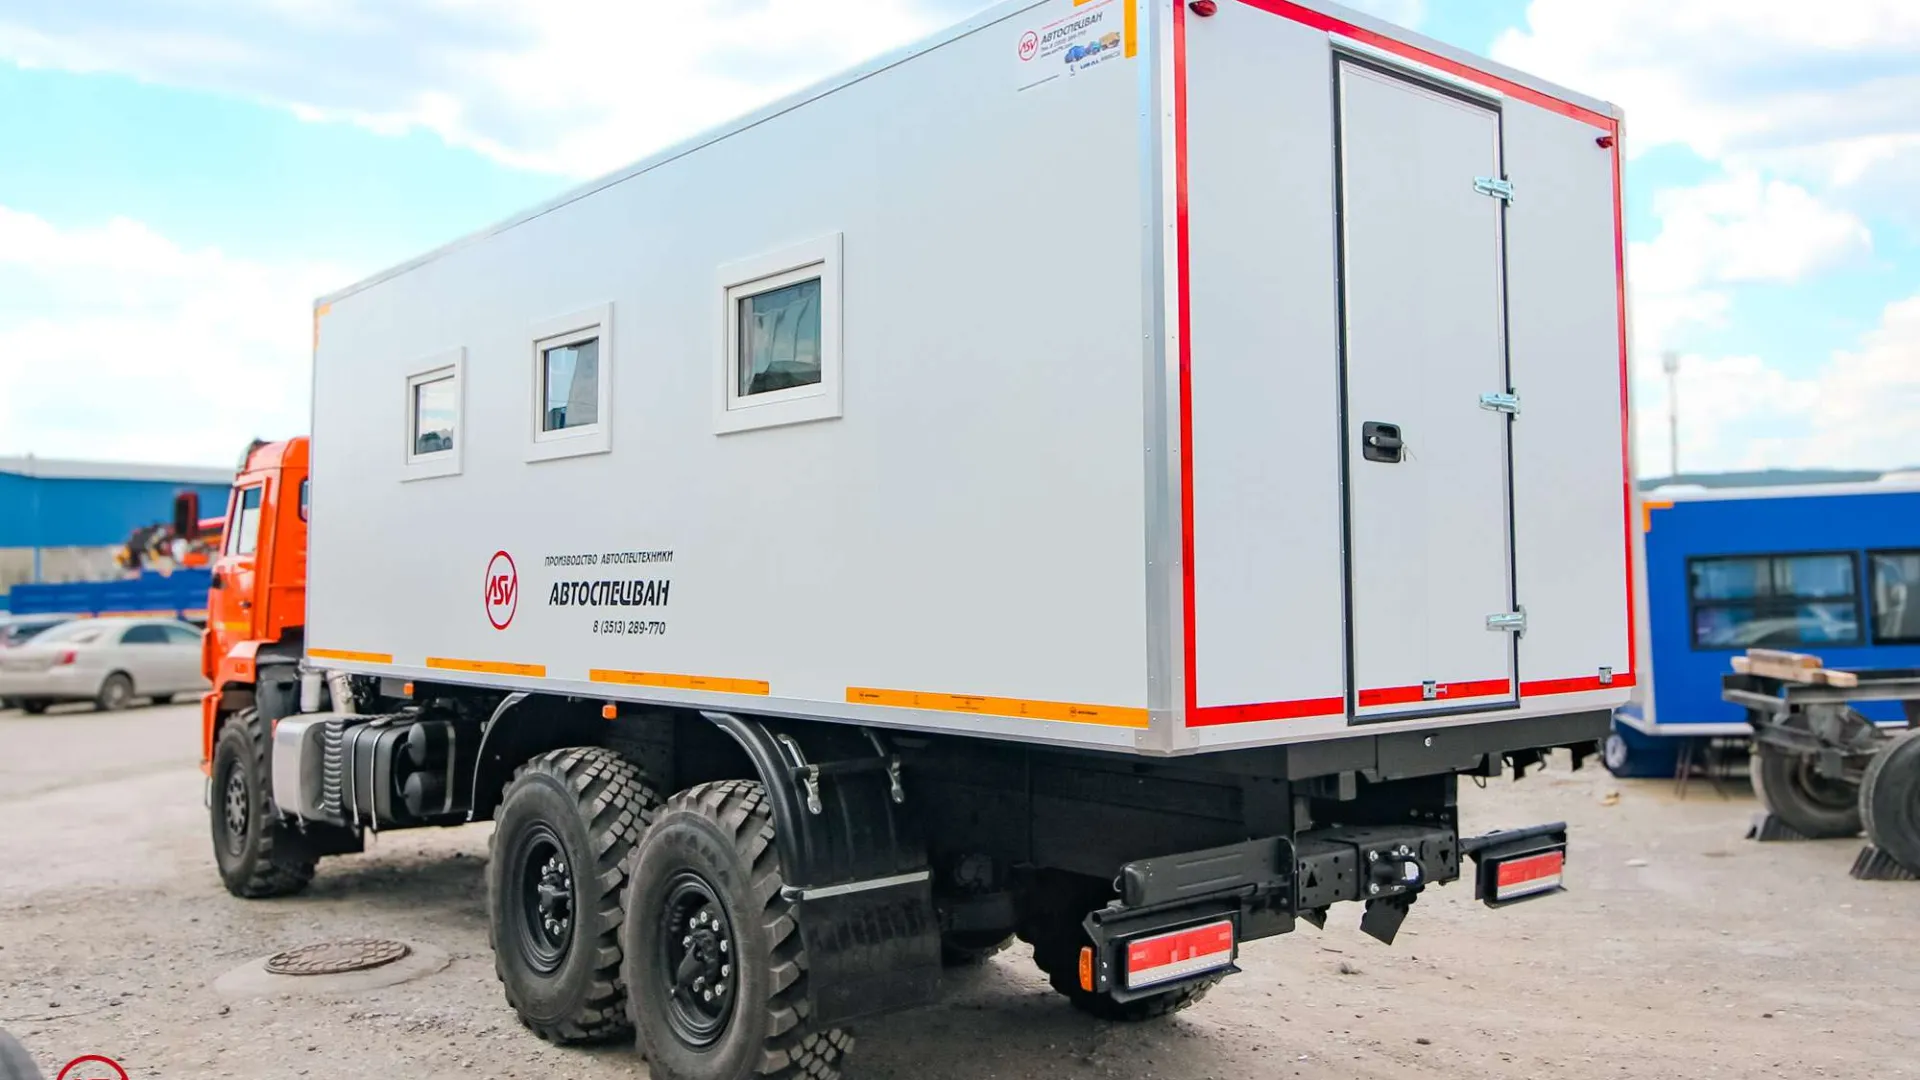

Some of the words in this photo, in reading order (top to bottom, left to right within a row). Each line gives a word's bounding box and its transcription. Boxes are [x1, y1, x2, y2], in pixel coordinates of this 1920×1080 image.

[545, 554, 598, 567] ПРОИЗВОДСТВО
[601, 551, 674, 565] АВТОСПЕЦТЕХНИКИ
[486, 574, 517, 606] ASV
[549, 580, 671, 606] АВТОСПЕЦВАН
[593, 620, 599, 634] 8
[601, 620, 626, 636] (3513)
[628, 620, 666, 636] 289-770
